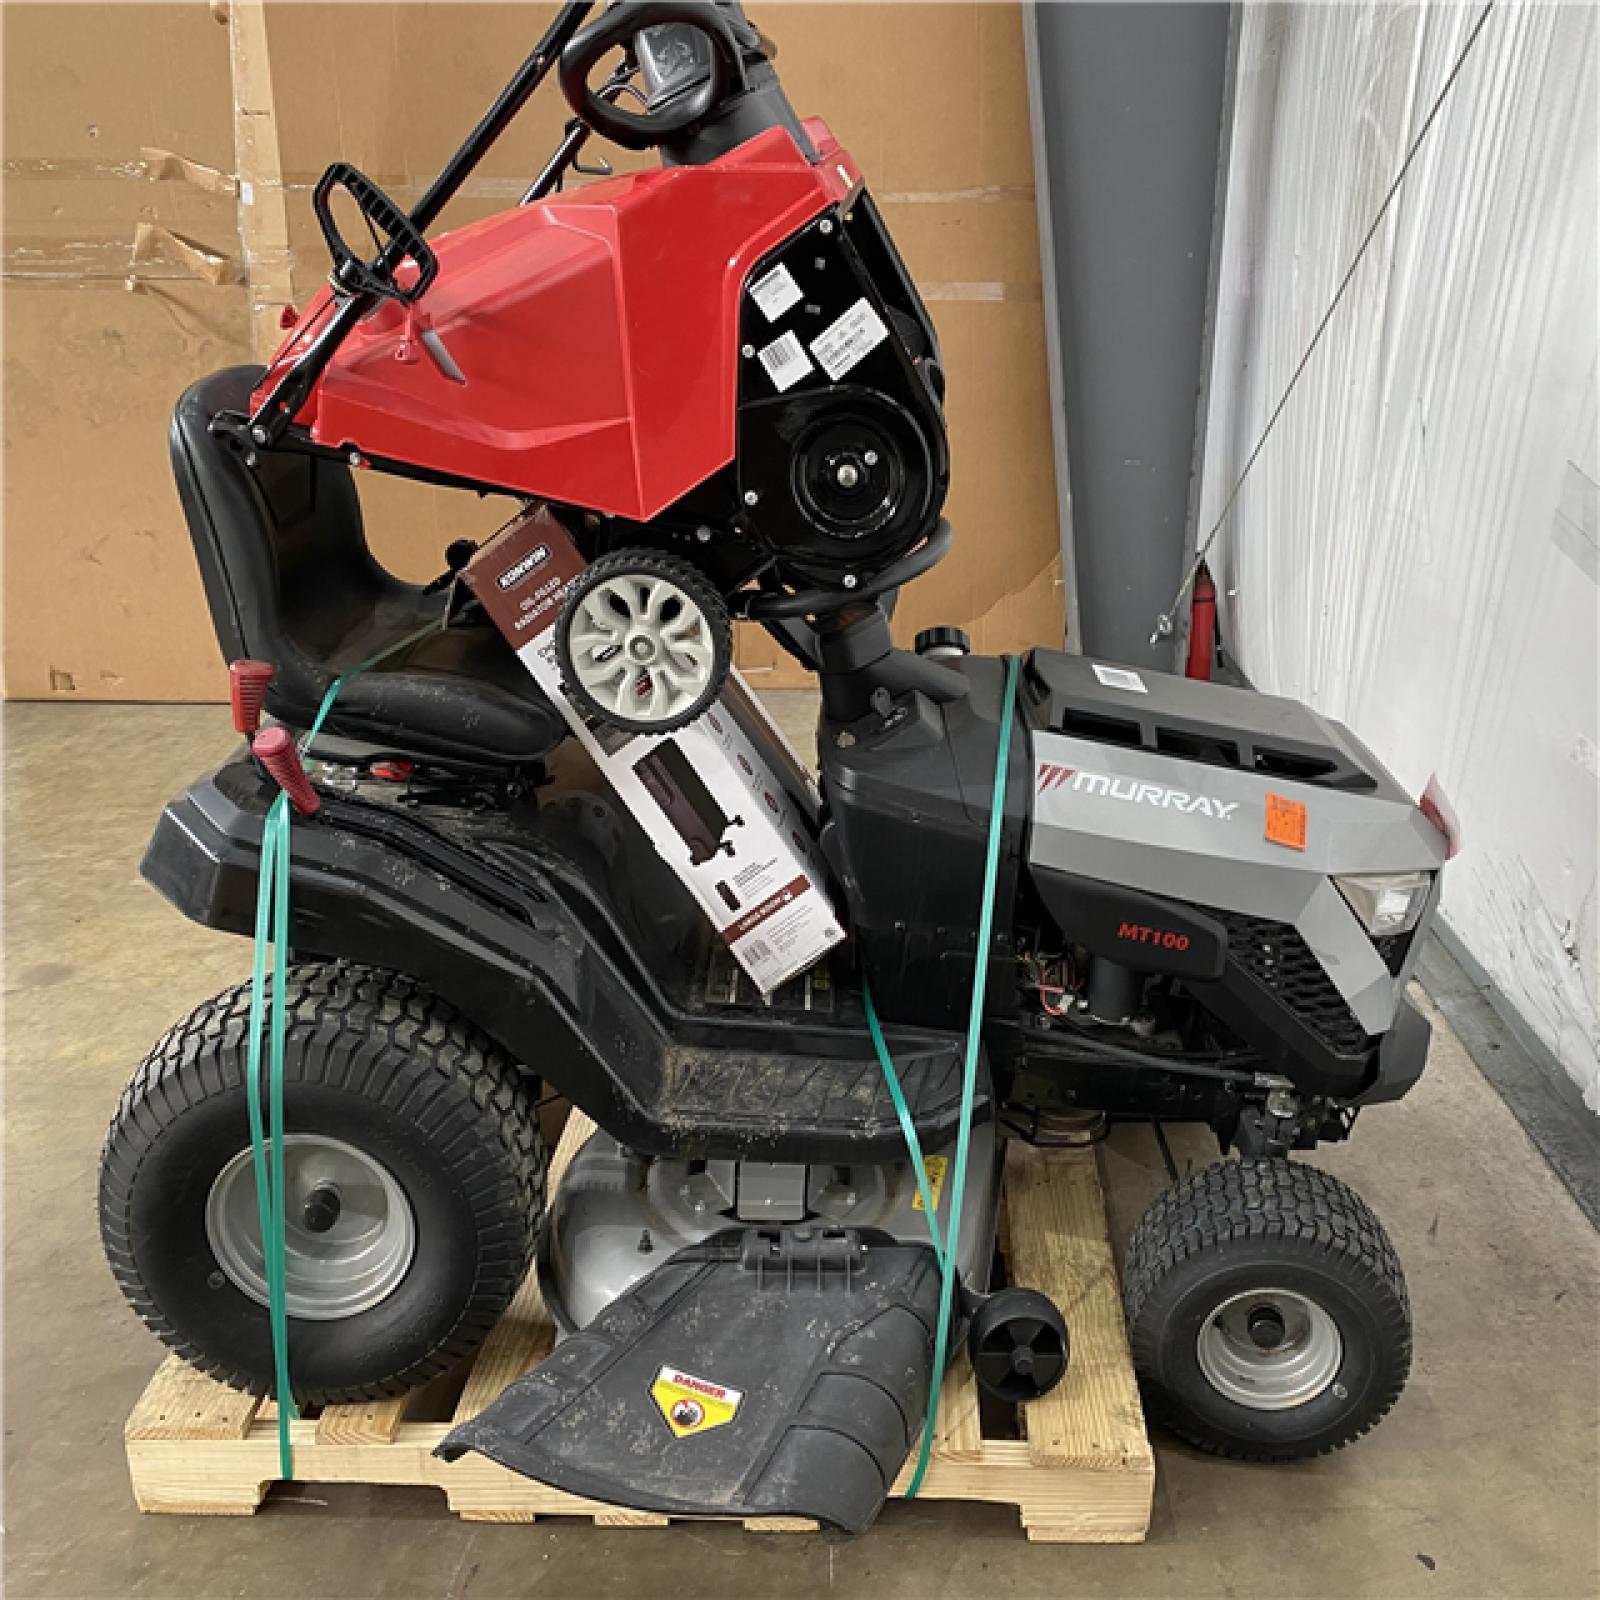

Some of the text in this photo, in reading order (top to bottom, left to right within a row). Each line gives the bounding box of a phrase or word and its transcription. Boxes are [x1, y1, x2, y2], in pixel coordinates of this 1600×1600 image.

[1071, 772, 1240, 819] MURRAY
[1117, 921, 1190, 951] MT100
[673, 1374, 727, 1400] DANGER
